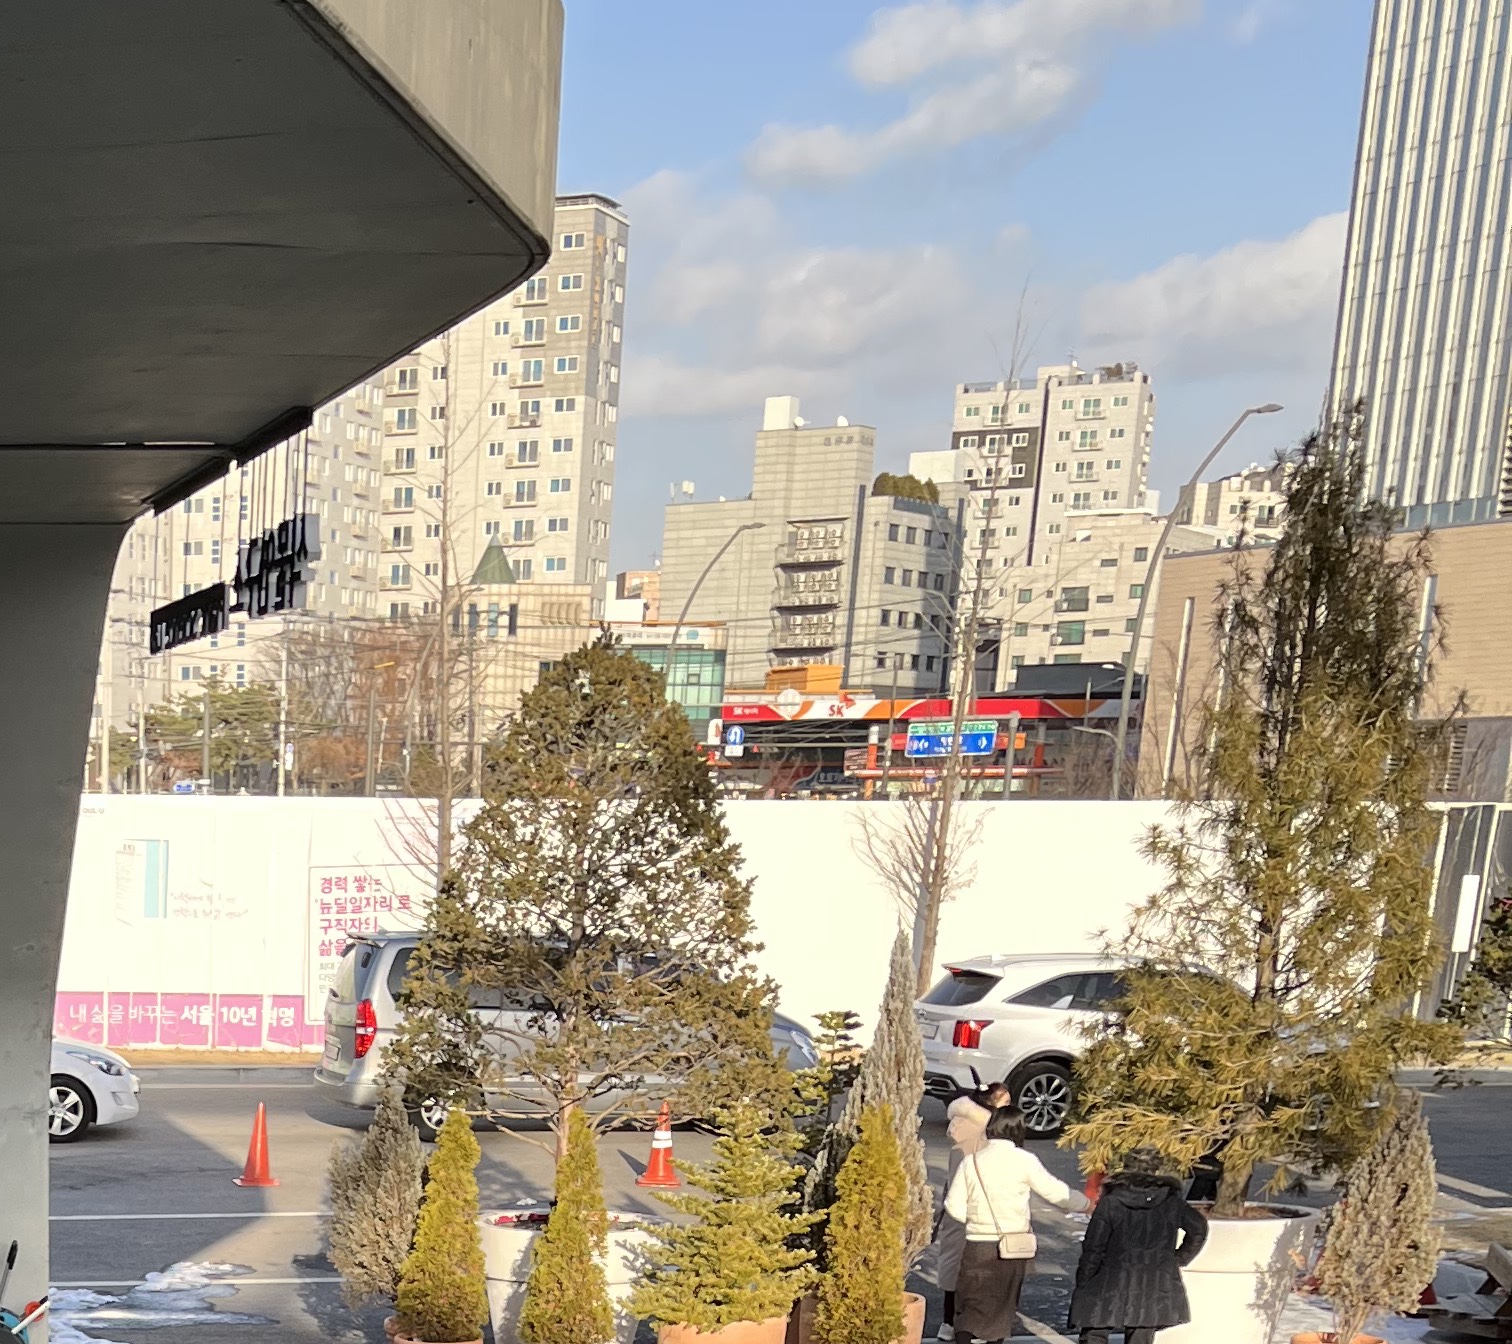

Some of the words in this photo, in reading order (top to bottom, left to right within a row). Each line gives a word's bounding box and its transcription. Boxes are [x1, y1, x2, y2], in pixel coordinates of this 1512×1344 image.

[829, 704, 844, 717] SK
[320, 876, 347, 894] 경력
[319, 916, 377, 935] 구직자의
[319, 938, 346, 956] 삶을
[69, 1004, 86, 1023] 내
[129, 1004, 177, 1024] 바꾸는
[180, 1005, 215, 1026] 서울
[220, 1006, 257, 1026] 10년
